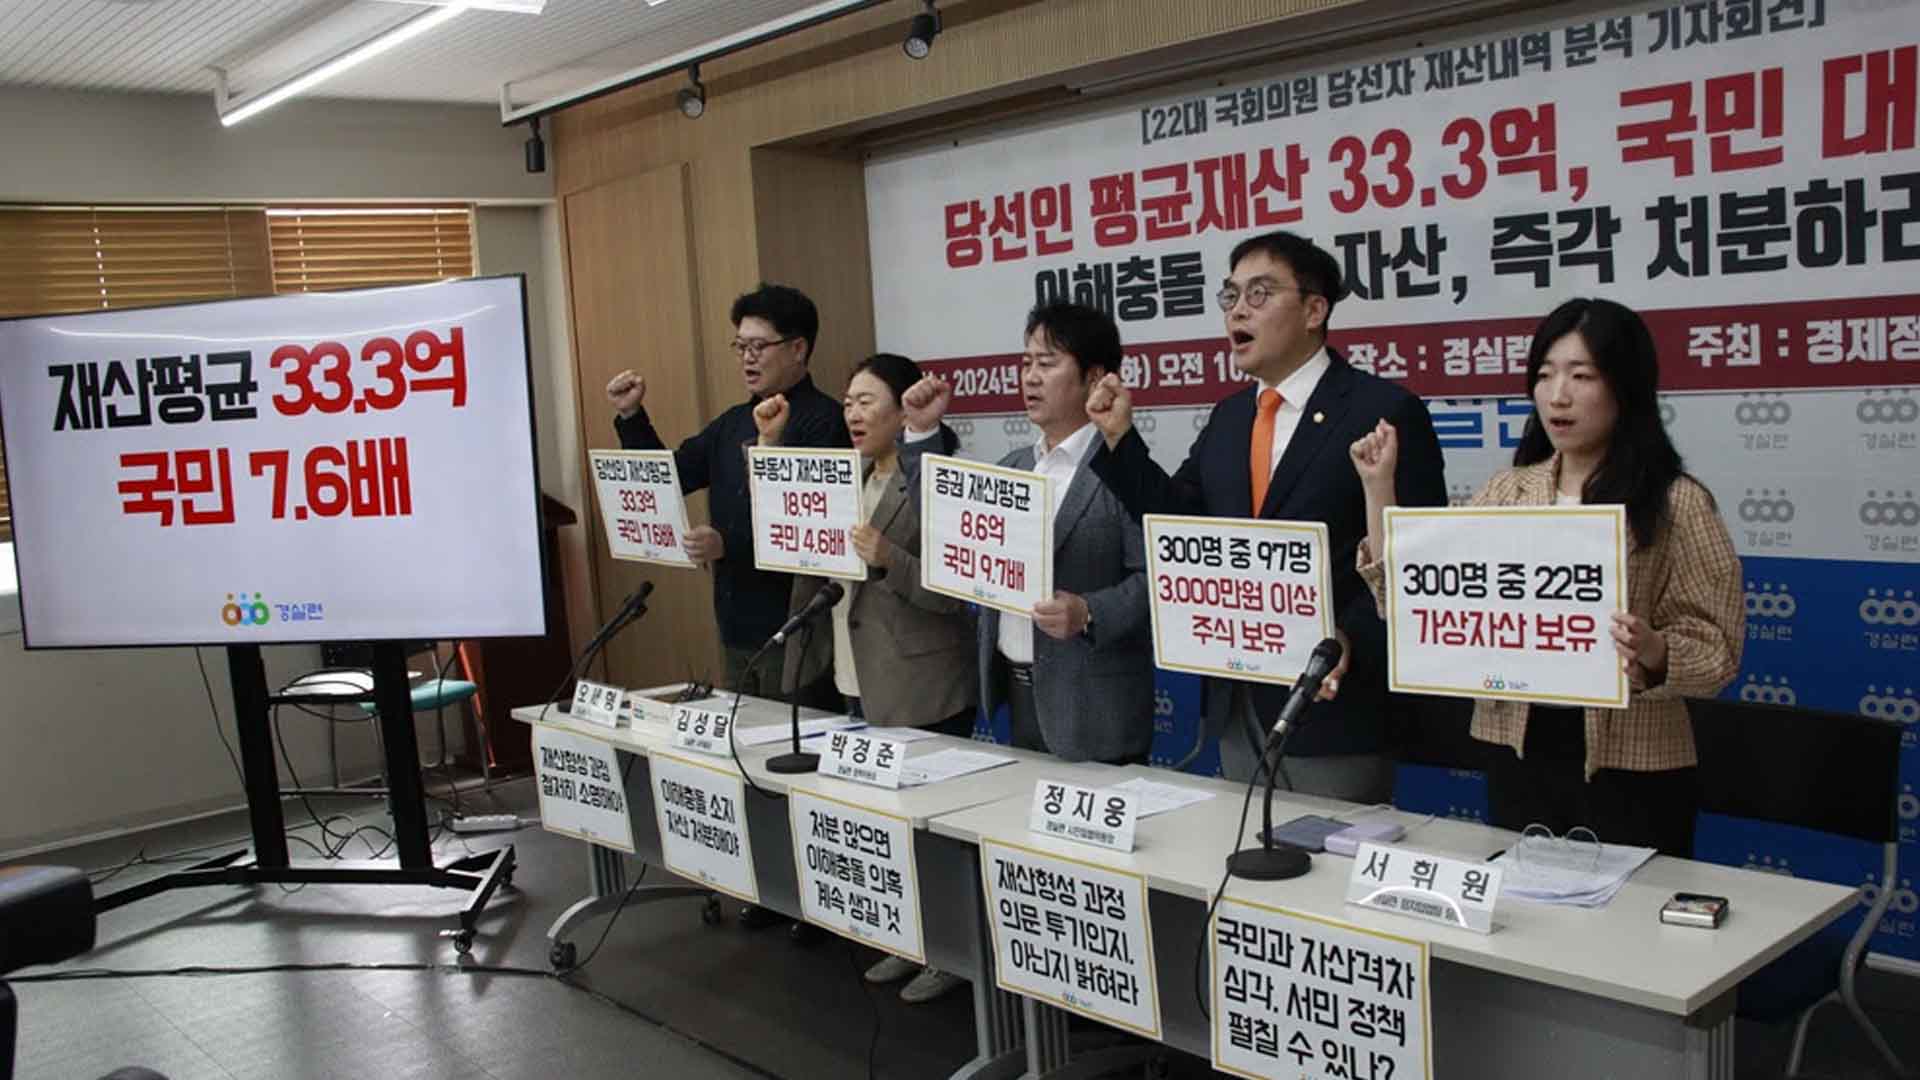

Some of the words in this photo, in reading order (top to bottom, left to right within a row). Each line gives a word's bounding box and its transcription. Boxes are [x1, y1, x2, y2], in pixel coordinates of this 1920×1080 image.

[1142, 98, 1207, 146] [22대
[1215, 77, 1318, 128] 국회의원
[1328, 59, 1414, 107] 당선자
[1424, 31, 1552, 92] 재산내역
[1564, 17, 1634, 68] 분석
[944, 183, 1074, 269] 당선인
[1090, 143, 1309, 249] 평균재산
[1328, 102, 1589, 213] 33.3억,
[1617, 66, 1784, 178] 국민
[1822, 44, 1918, 160] 대
[1035, 252, 1206, 323] 이해충돌
[1335, 223, 1468, 305] 자산,
[1491, 205, 1622, 289] 즉각
[1348, 342, 1408, 379] 장소
[1689, 324, 1761, 368] 주최
[48, 349, 258, 431] 재산평균
[270, 326, 467, 416] 33.3억
[1158, 351, 1205, 387] 오전
[116, 448, 235, 526] 국민
[248, 436, 412, 520] 7.6배
[595, 458, 628, 481] 당선인
[630, 458, 672, 484] 재산평균
[753, 457, 792, 483] 부동산
[797, 458, 853, 484] 재산평균
[936, 467, 965, 498] 증권
[968, 475, 1031, 512] 재산평균
[619, 489, 657, 515] 33.3억
[783, 491, 827, 518] 18.9억
[617, 518, 643, 544] 국민
[644, 519, 677, 548] 7.6배
[770, 524, 799, 552] 국민
[803, 528, 847, 556] 4.6배
[960, 511, 1006, 546] 8.6억
[944, 544, 976, 579] 국민
[980, 554, 1025, 592] 9.7배
[1158, 535, 1223, 567] 300명
[1229, 538, 1251, 569] 중
[1258, 541, 1311, 574] 97명
[1270, 583, 1317, 617] 이상
[1403, 563, 1487, 599] 300명
[1497, 564, 1526, 599] 중
[1535, 564, 1603, 602] 22명
[274, 601, 325, 622] 경실련
[1412, 609, 1527, 648] 가상자산
[1535, 614, 1597, 652] 보유
[1192, 615, 1235, 648] 주식
[1242, 621, 1286, 654] 보유
[540, 746, 588, 776] 재산형성
[588, 756, 611, 783] 과정
[661, 778, 707, 816] 이해충돌
[710, 793, 736, 824] 소지
[690, 819, 739, 857] 처분해야
[810, 809, 840, 844] 처분
[843, 818, 891, 860] 않으면
[806, 844, 866, 889] 이해충돌
[869, 864, 904, 899] 의혹
[995, 858, 1077, 907] 재산형성
[1081, 880, 1126, 921] 과정
[815, 880, 846, 915] 계속
[848, 891, 880, 927] 생길
[883, 903, 901, 935] 것
[1000, 898, 1041, 936] 의문
[1010, 938, 1070, 984] 아닌지
[1074, 957, 1139, 1006] 밝혀라
[1217, 916, 1294, 969] 국민과
[1301, 936, 1415, 1000] 자산격차
[1286, 982, 1339, 1030] 서민
[1348, 997, 1405, 1047] 정책
[1228, 1011, 1279, 1058] 펼칠
[1287, 1030, 1314, 1065] 수
[1322, 1039, 1395, 1080] 있나?
